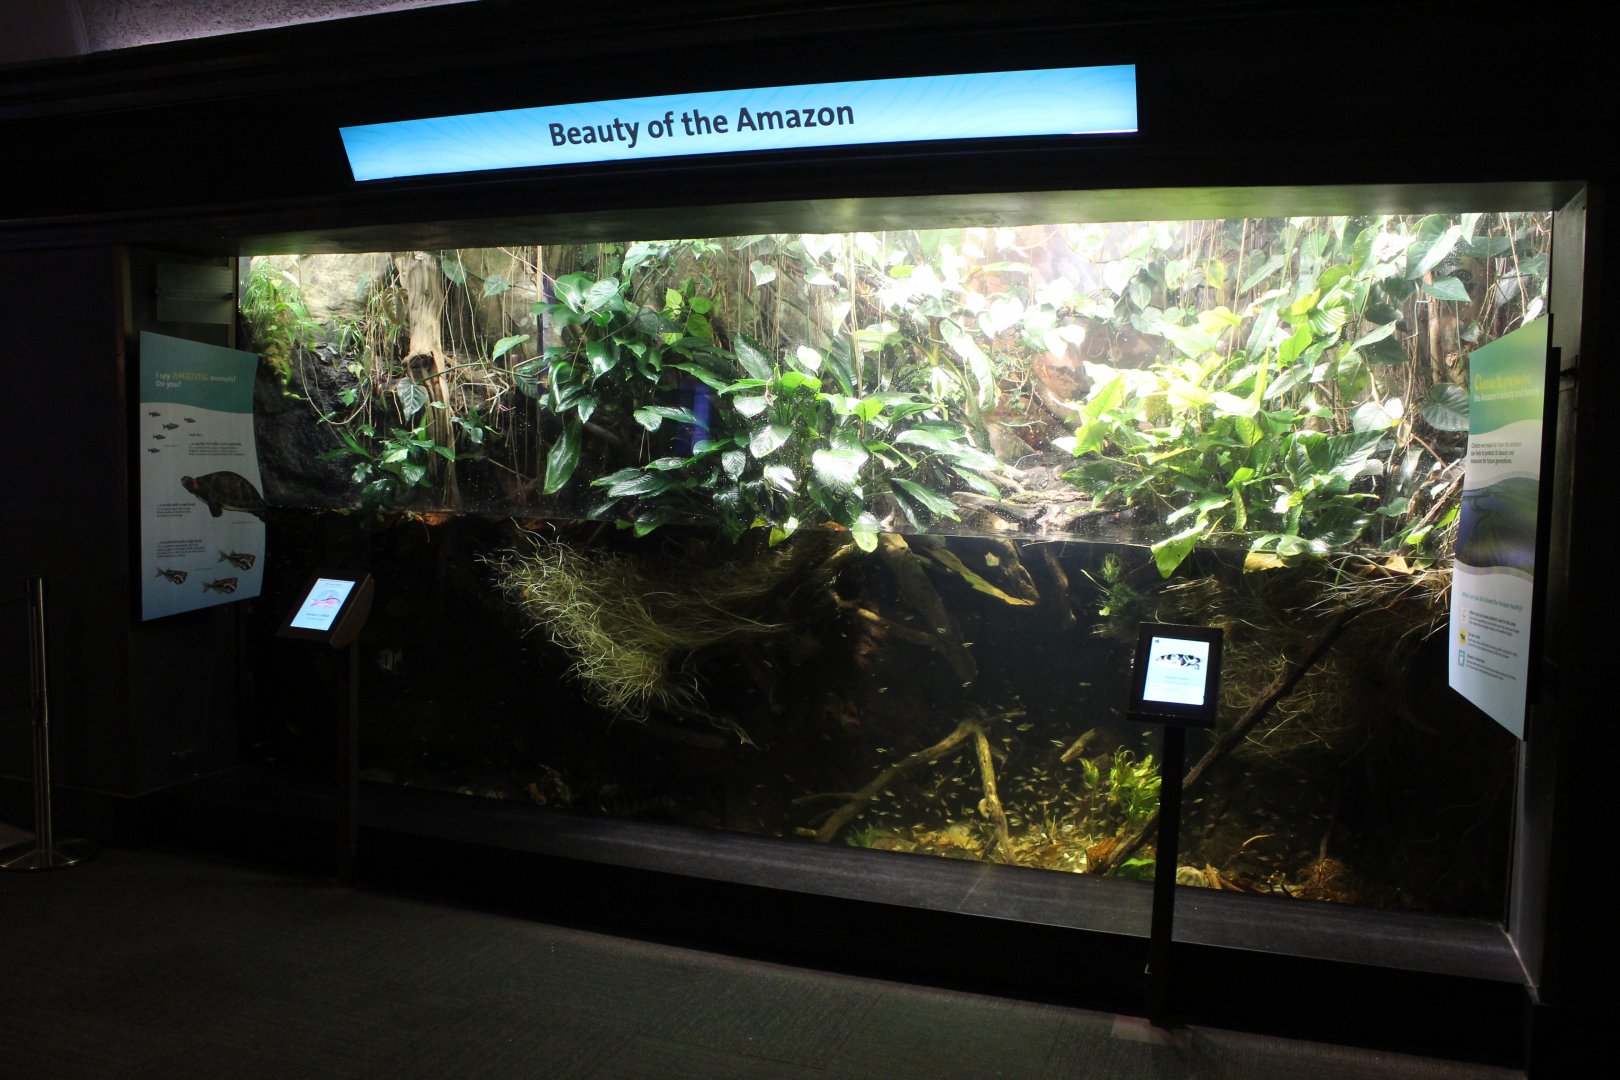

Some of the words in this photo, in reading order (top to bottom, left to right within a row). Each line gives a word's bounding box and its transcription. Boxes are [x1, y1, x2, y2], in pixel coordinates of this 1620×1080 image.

[549, 118, 640, 148] Beauty
[647, 111, 675, 139] of
[681, 109, 729, 136] the
[737, 105, 855, 132] Amazon
